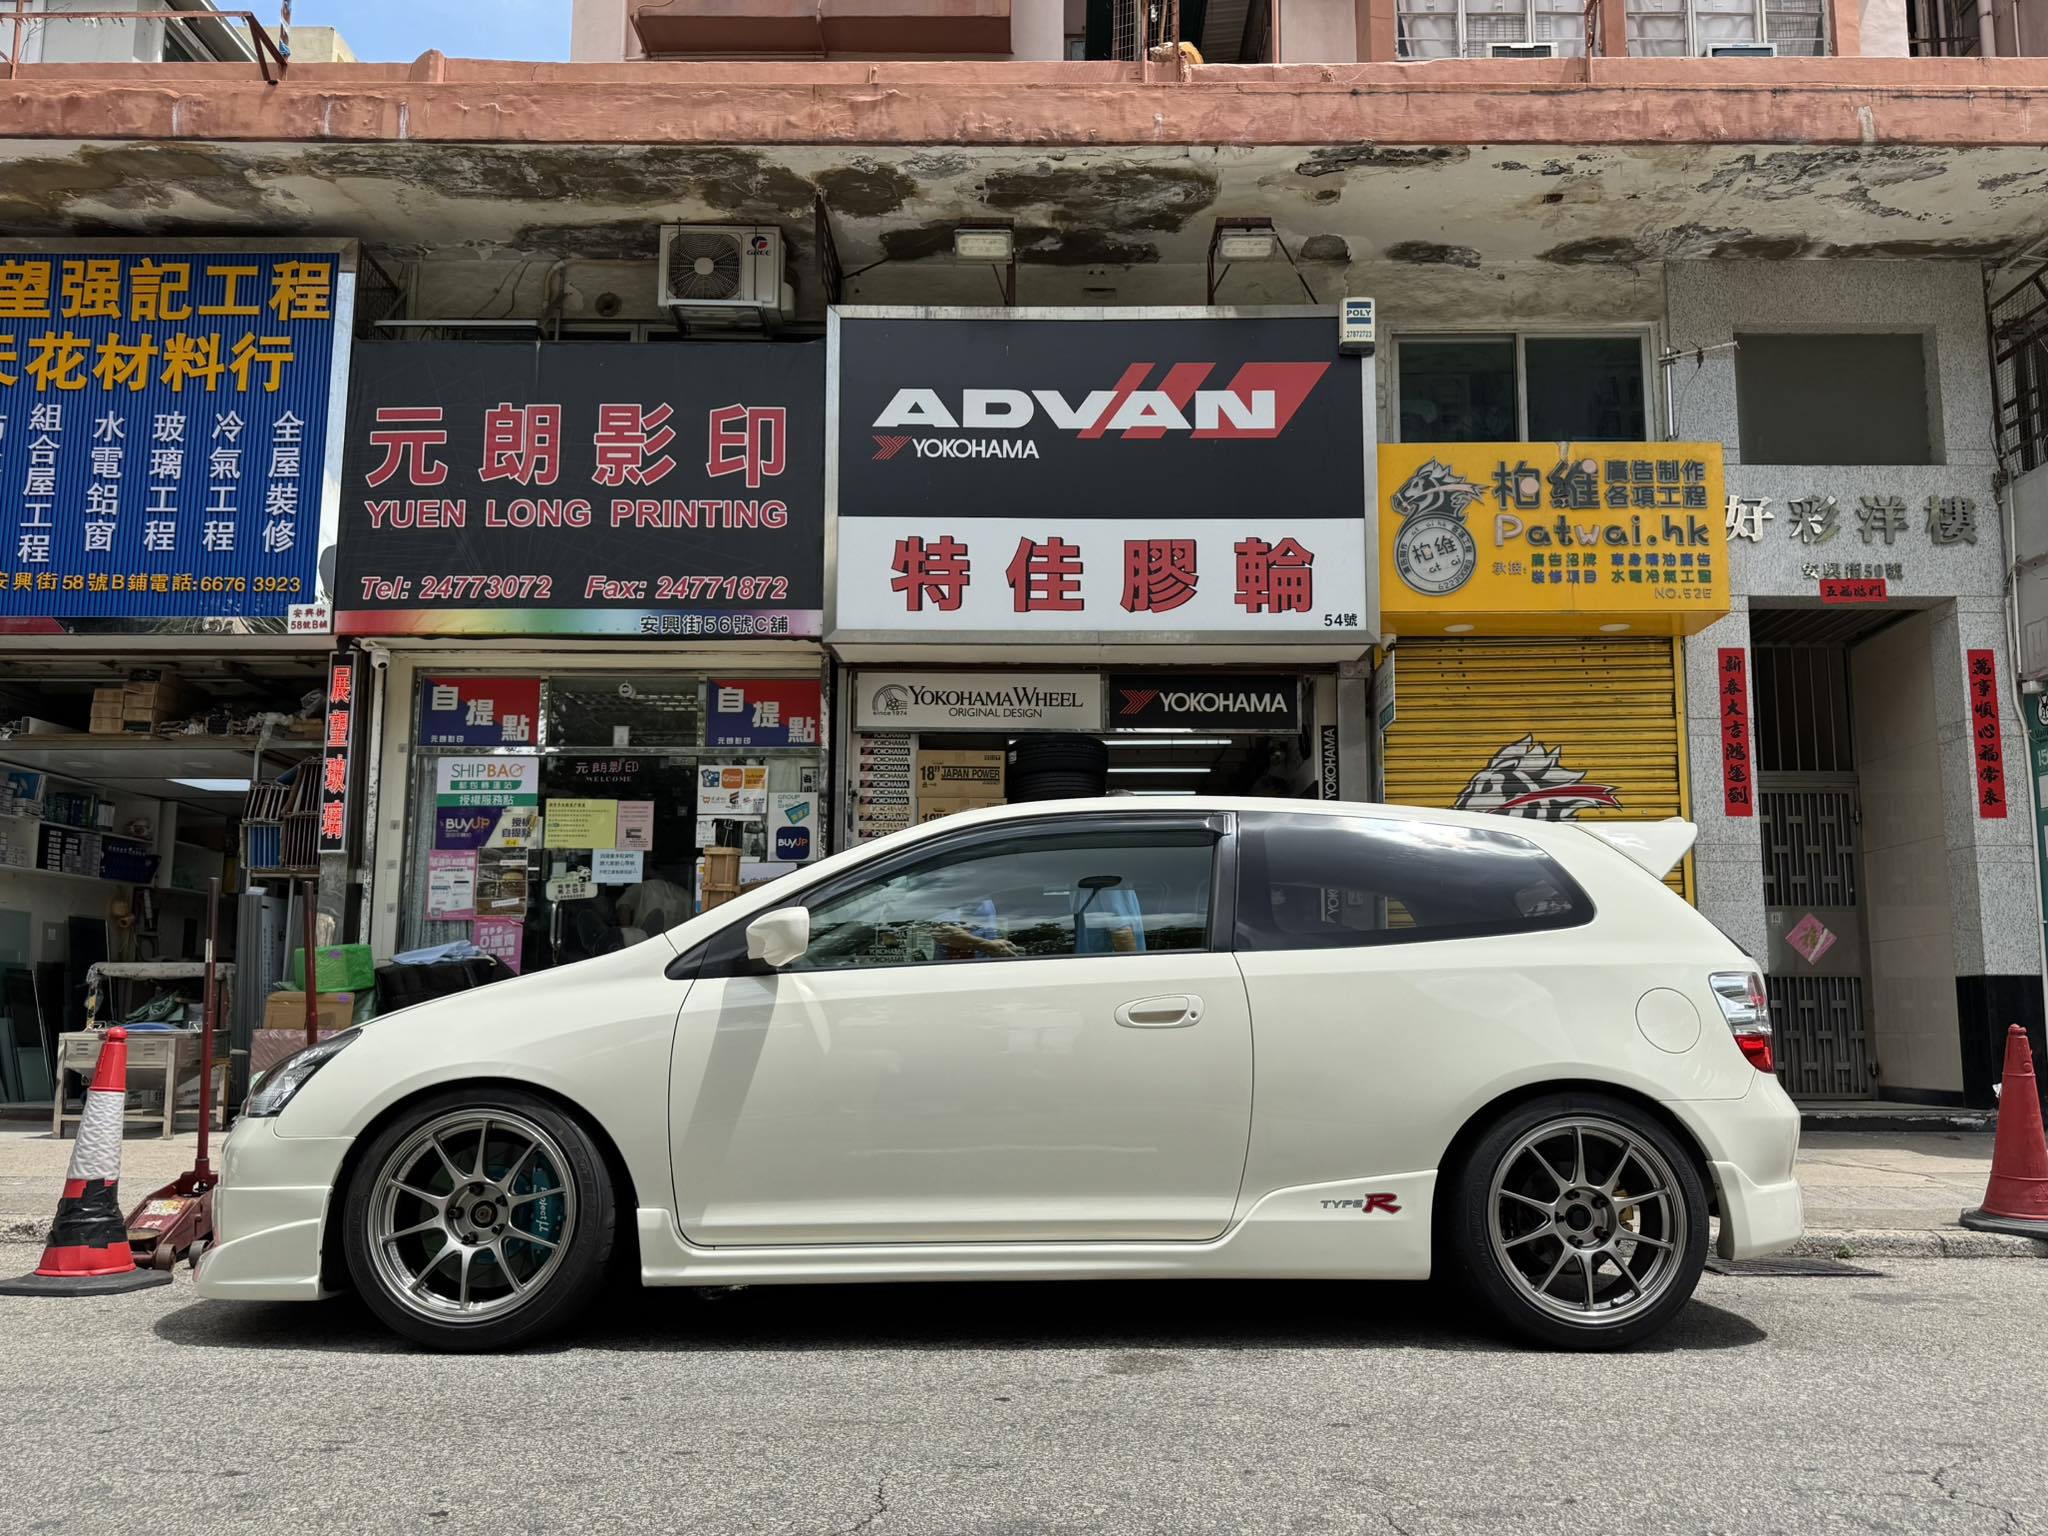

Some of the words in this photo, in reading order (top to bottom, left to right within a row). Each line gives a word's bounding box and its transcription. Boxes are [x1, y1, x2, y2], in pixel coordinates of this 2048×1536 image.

[1346, 309, 1371, 317] POLY
[0, 331, 294, 392] 花材料行
[872, 388, 1276, 430] ADVAN
[365, 402, 788, 488] 元朗影印
[912, 438, 1039, 459] YOKOHAMA
[17, 402, 63, 564] 組合屋工程
[84, 410, 126, 552] 水電鋁窗
[143, 411, 188, 552] 玻璃工程
[202, 410, 245, 552] 冷氣工程
[262, 410, 305, 553] 全屋裝修
[1605, 485, 1709, 509] 各項工程
[365, 500, 466, 528] YUEN
[485, 499, 591, 527] LONG
[611, 499, 788, 528] PRINTING
[1725, 494, 1979, 544] 好彩洋樓
[1494, 514, 1711, 547] Patwai.hk
[361, 576, 411, 600] Tel:
[419, 575, 552, 600] 24773072
[584, 576, 645, 600] Fax:
[655, 576, 788, 600] 24771872
[891, 535, 1314, 613] 特佳膠輪
[1323, 612, 1358, 628] 54號
[431, 684, 530, 741] 自提點
[908, 686, 1012, 707] YOKOHAMA
[1012, 686, 1083, 708] WHEEL
[948, 707, 1000, 717] ORIGINAL
[1003, 708, 1042, 718] DESIGN
[1160, 691, 1287, 713] YOKOHAMA
[718, 687, 816, 743] 自提點
[450, 763, 527, 778] SHIPBAO
[575, 760, 640, 774] 元朗影印
[941, 768, 970, 779] JAPAN
[971, 769, 1001, 779] POWER
[1325, 728, 1337, 799] YOKOHAMA
[1320, 1199, 1364, 1209] TYPE
[1362, 1192, 1402, 1215] R
